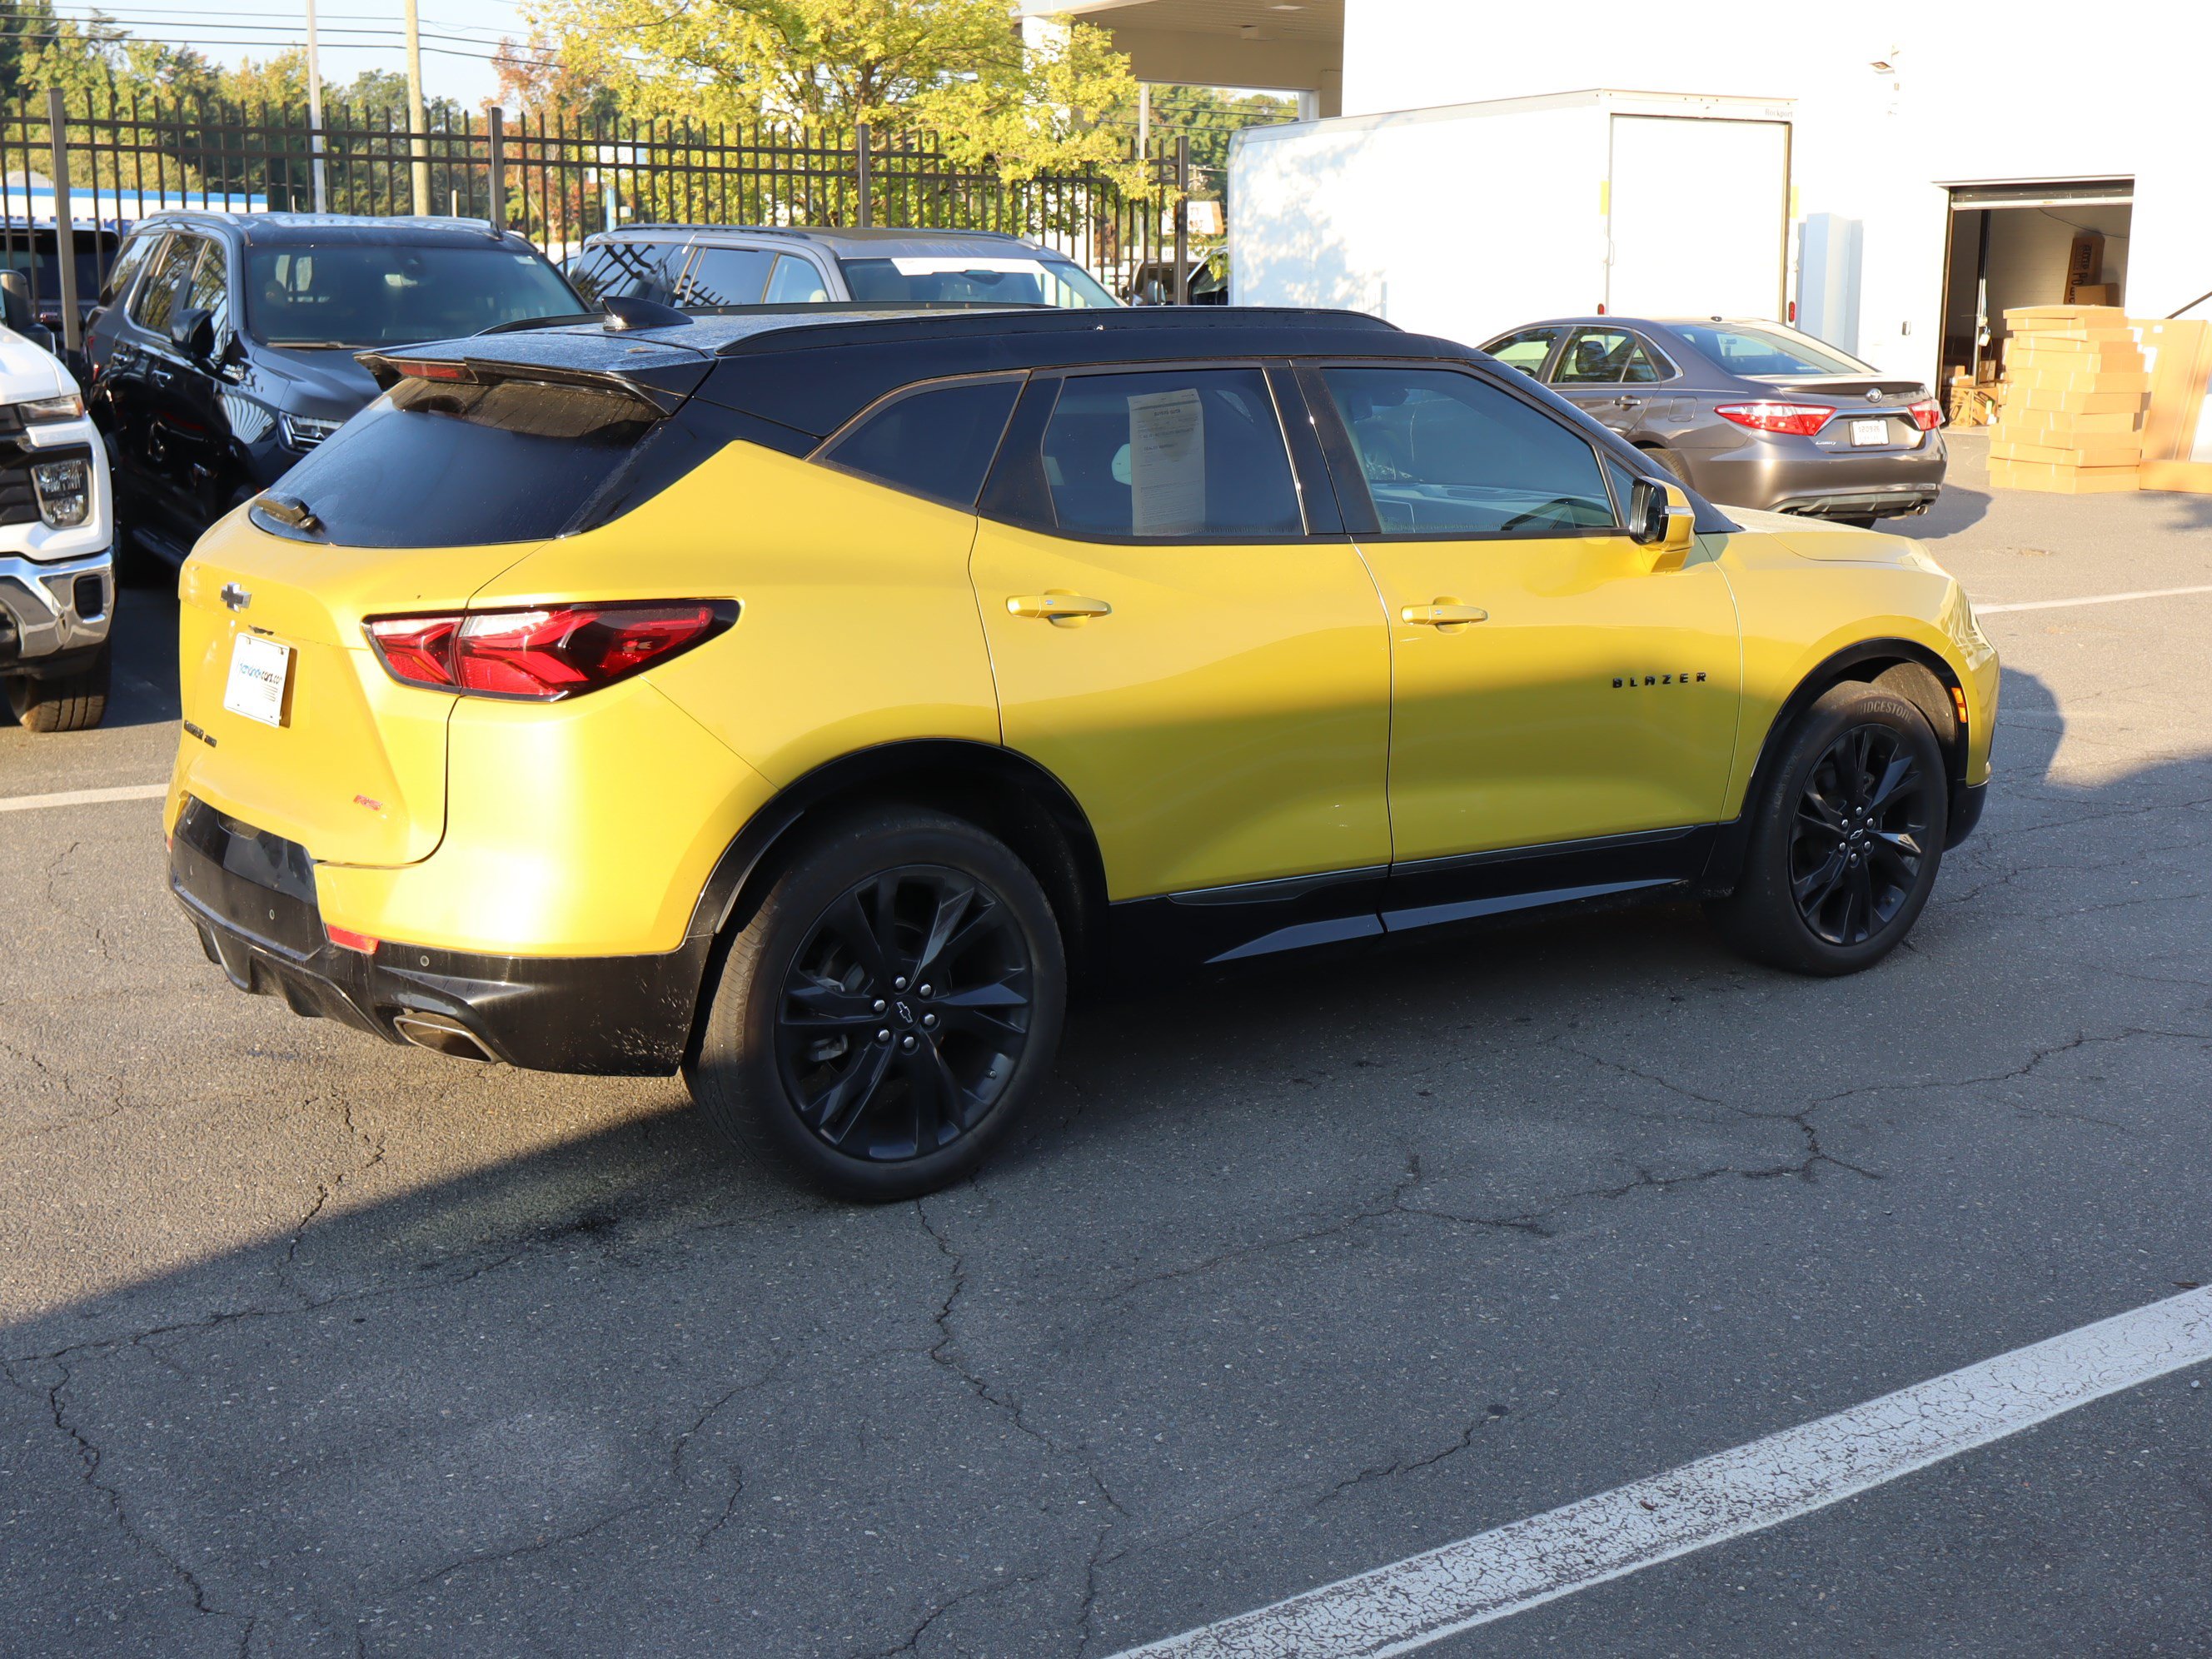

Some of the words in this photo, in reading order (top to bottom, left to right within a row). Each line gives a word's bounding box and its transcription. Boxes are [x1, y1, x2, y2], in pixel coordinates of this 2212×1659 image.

[1765, 108, 1793, 118] Rockport
[1612, 672, 1706, 688] BLAZER
[353, 795, 381, 812] RS
